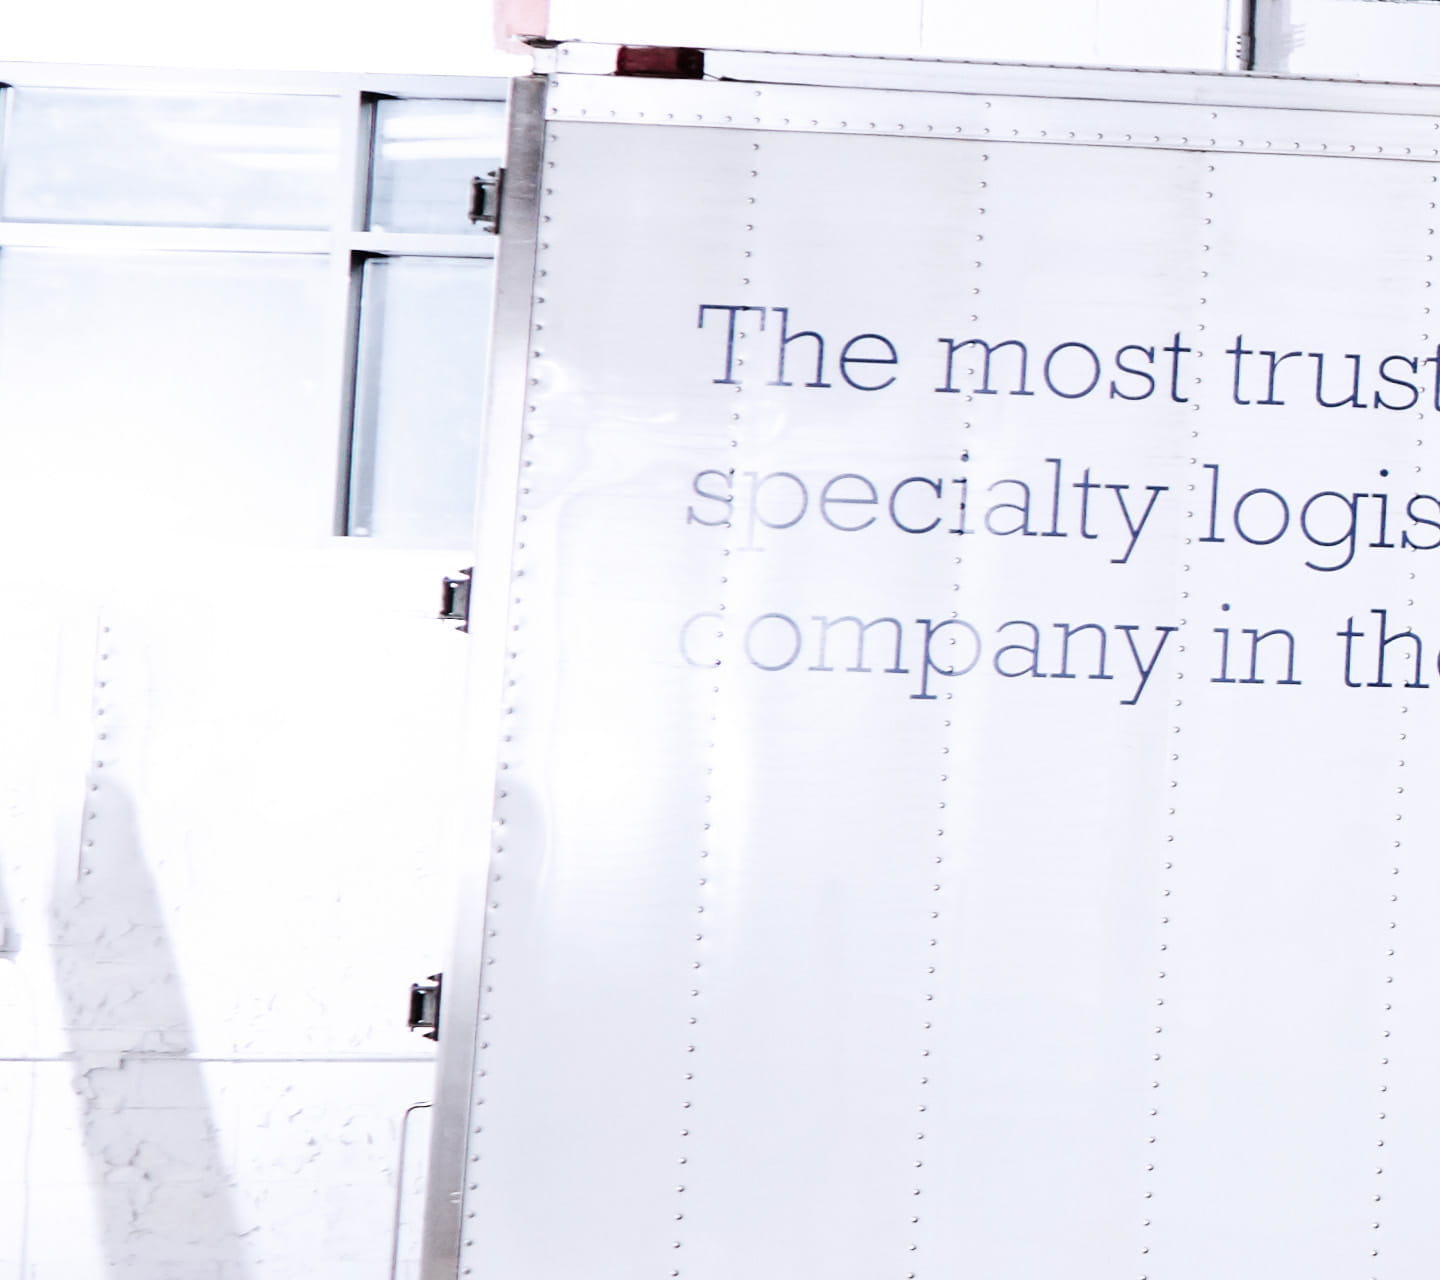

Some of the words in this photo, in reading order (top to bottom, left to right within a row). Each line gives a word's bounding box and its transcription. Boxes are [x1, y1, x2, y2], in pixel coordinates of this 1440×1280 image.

[695, 303, 900, 392] The
[933, 330, 1194, 405] most
[685, 450, 1171, 566] specialty
[680, 610, 1181, 707] company
[1208, 602, 1303, 687] in
